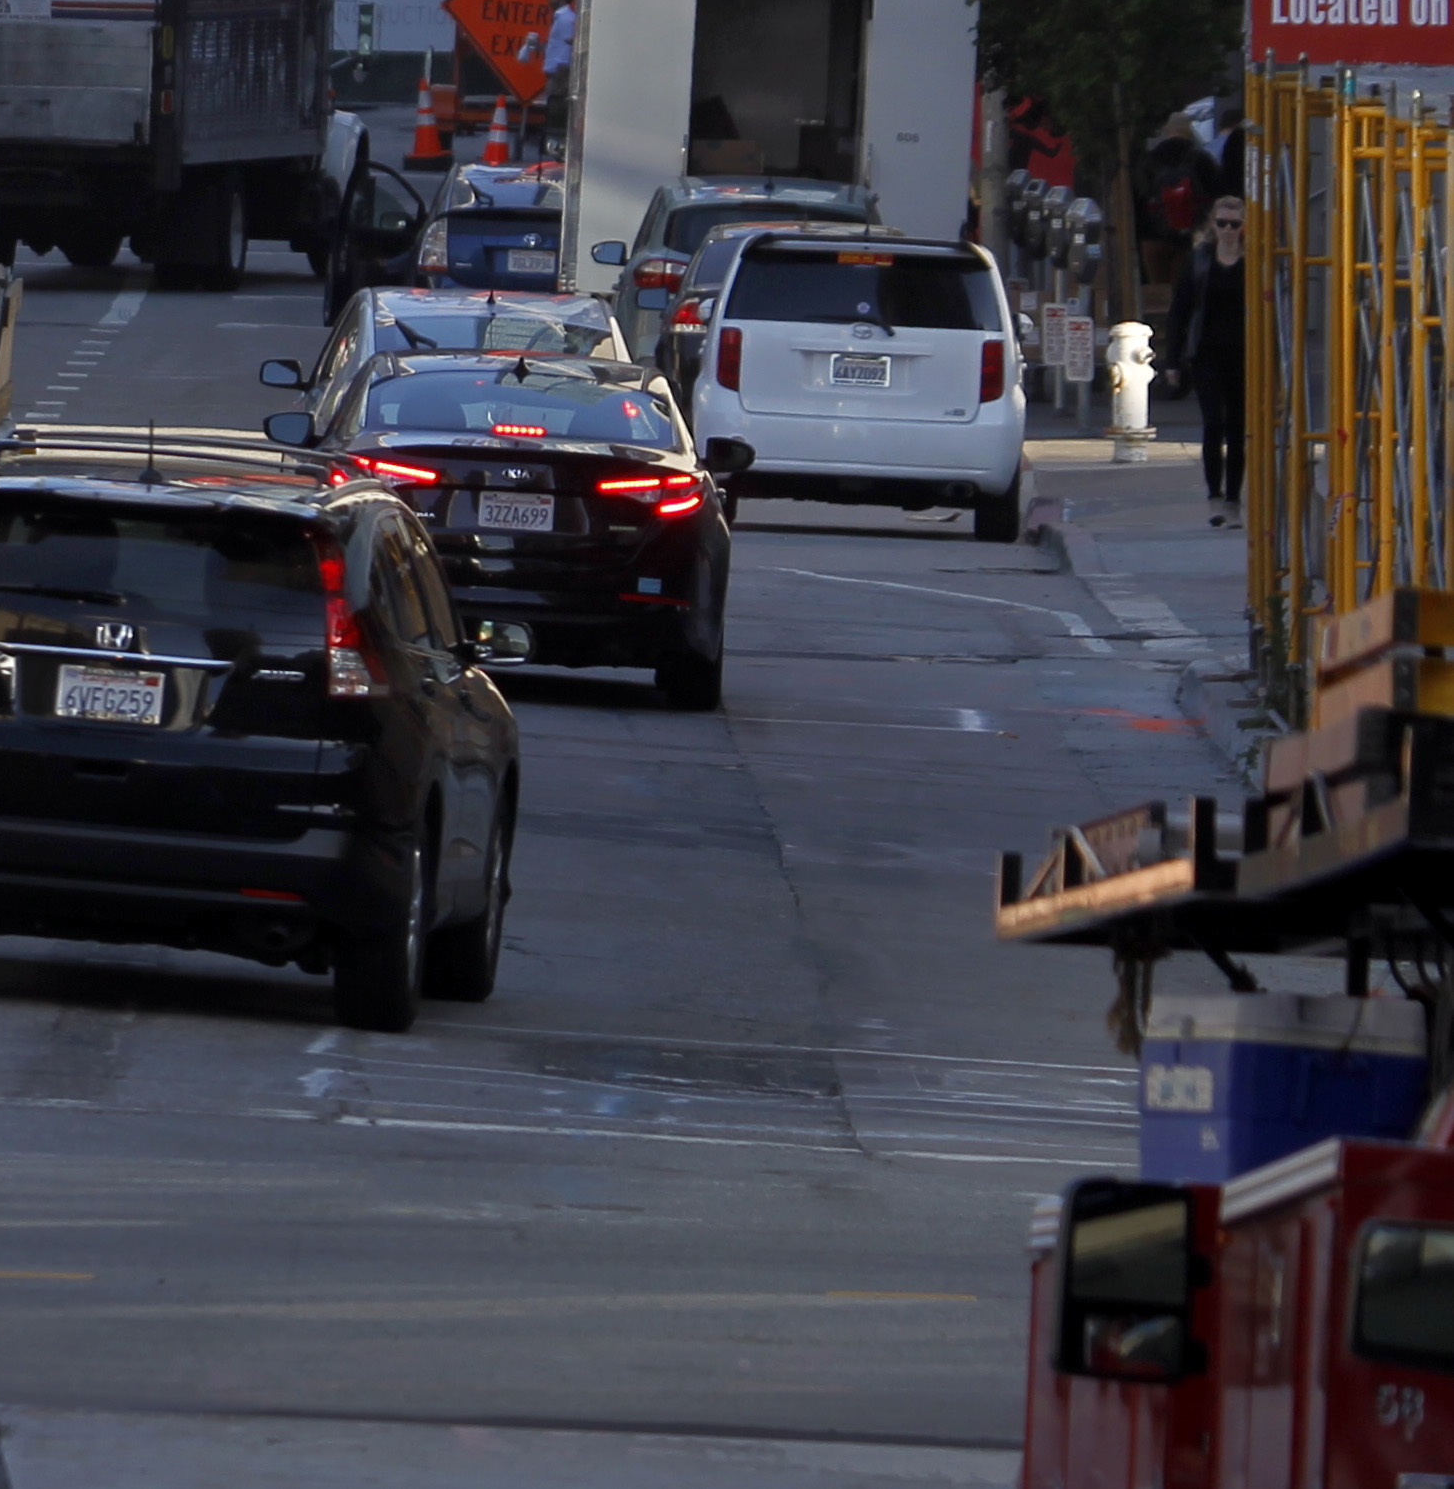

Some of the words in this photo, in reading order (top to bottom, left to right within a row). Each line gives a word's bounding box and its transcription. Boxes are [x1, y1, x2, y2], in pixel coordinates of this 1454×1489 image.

[507, 468, 531, 479] KIA
[484, 504, 549, 526] 3ZZA699
[65, 685, 155, 717] 6VFG259
